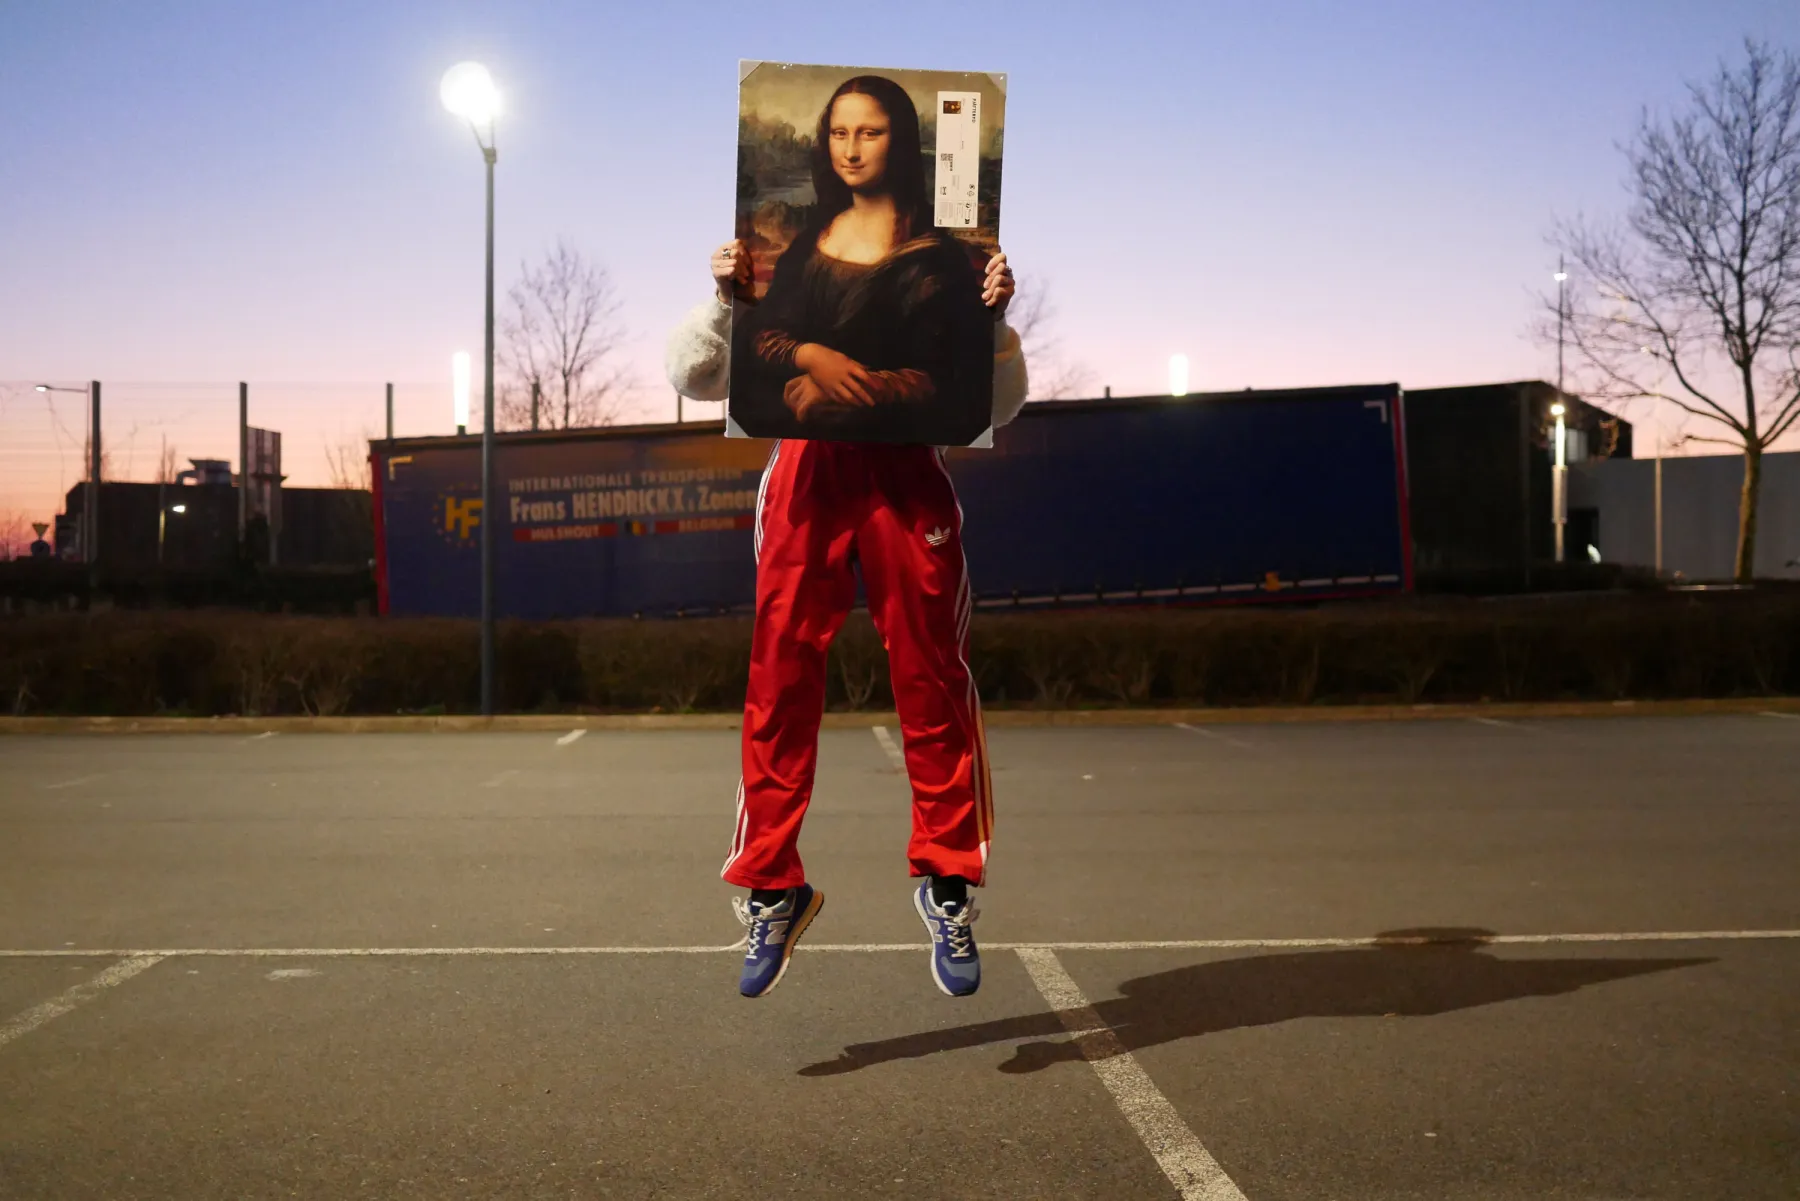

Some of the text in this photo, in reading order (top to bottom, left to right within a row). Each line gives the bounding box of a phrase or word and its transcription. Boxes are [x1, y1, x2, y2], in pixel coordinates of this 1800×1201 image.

[509, 473, 631, 492] INTERNATIONALE
[510, 495, 566, 523] Frans
[572, 489, 685, 518] HENDRICKX
[696, 486, 757, 512] Zonen
